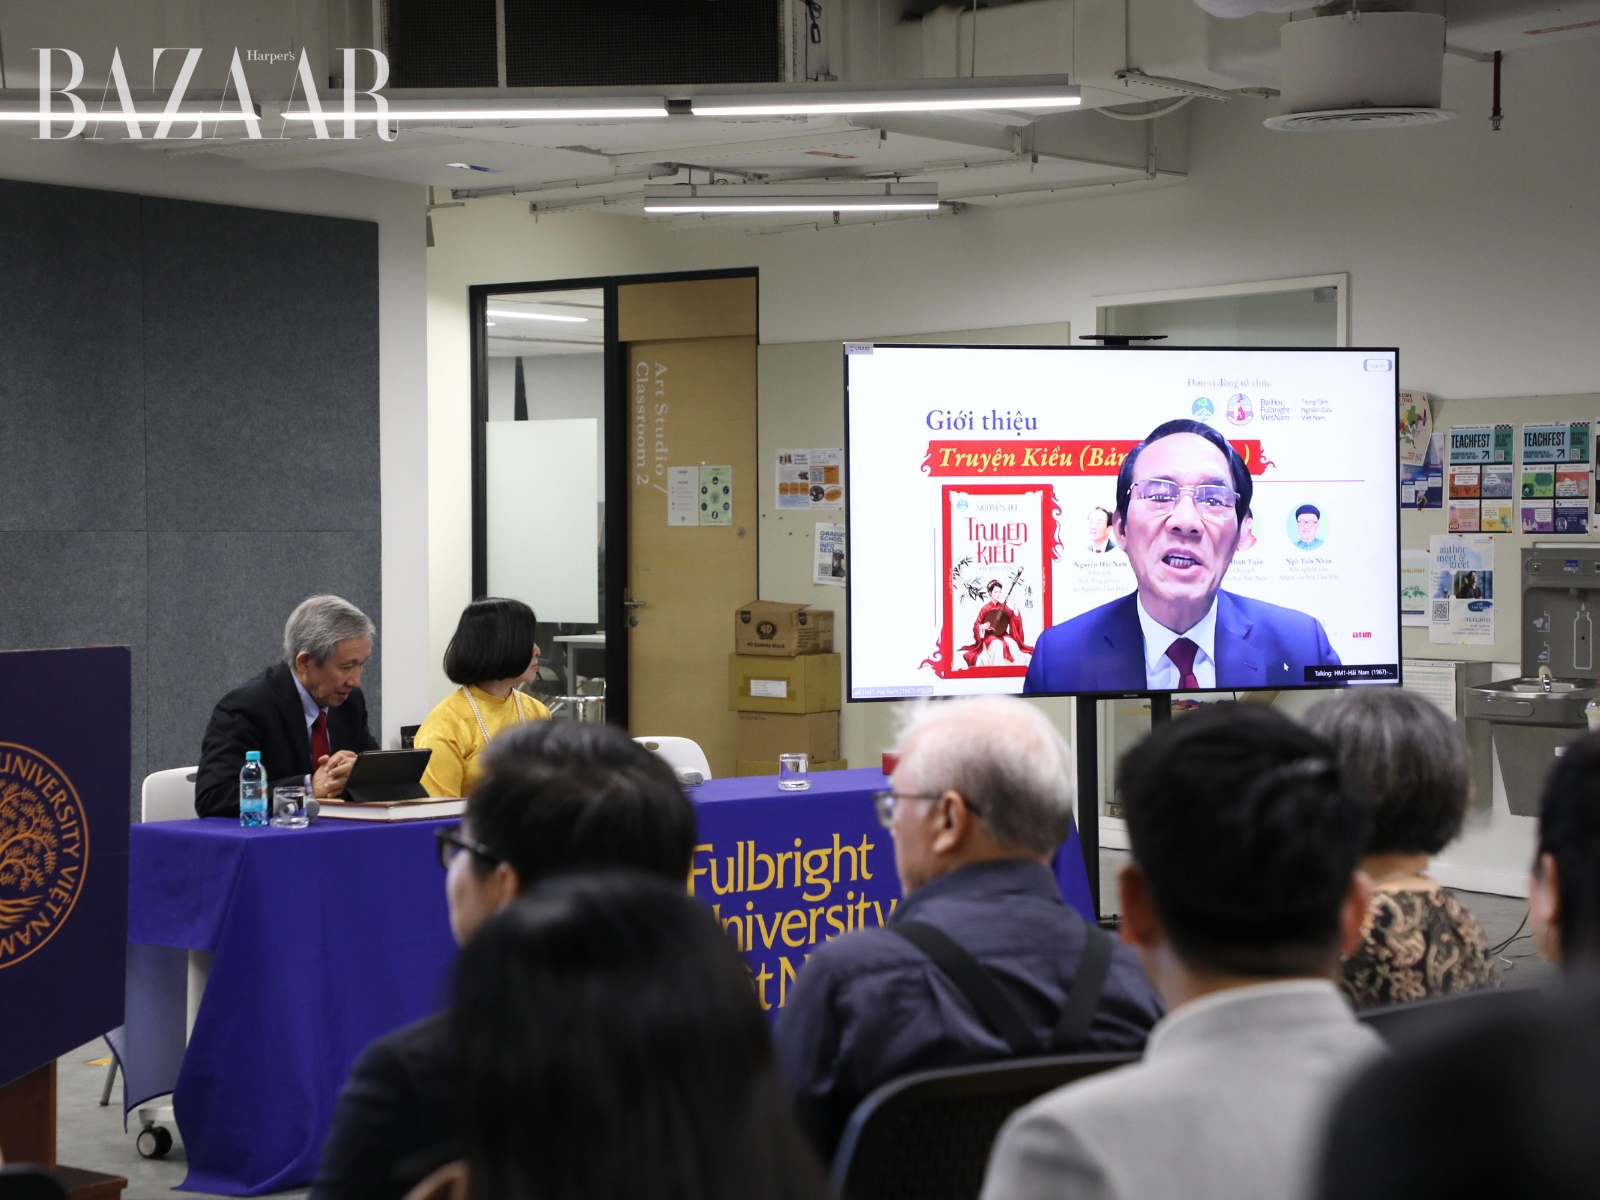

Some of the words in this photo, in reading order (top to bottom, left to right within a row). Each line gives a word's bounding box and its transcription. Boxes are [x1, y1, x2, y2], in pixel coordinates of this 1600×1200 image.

[654, 362, 668, 397] Art
[1187, 377, 1206, 387] Đơn
[636, 361, 649, 468] Classroom
[1260, 406, 1290, 415] Fulbright
[926, 409, 974, 431] Giới
[982, 408, 1038, 436] thiệu
[654, 403, 668, 476] Studio
[1451, 433, 1491, 449] TEACHFEST
[1524, 431, 1566, 447] TEACHFEST
[939, 447, 1016, 472] Truyện
[1021, 445, 1073, 467] Kiều
[636, 474, 649, 486] 2
[1439, 544, 1467, 554] author
[1112, 560, 1128, 568] Nam
[1436, 554, 1457, 562] meet
[1449, 560, 1470, 570] greet
[686, 832, 875, 902] Fulbright
[49, 865, 80, 919] VIỆT
[711, 890, 898, 952] niversity
